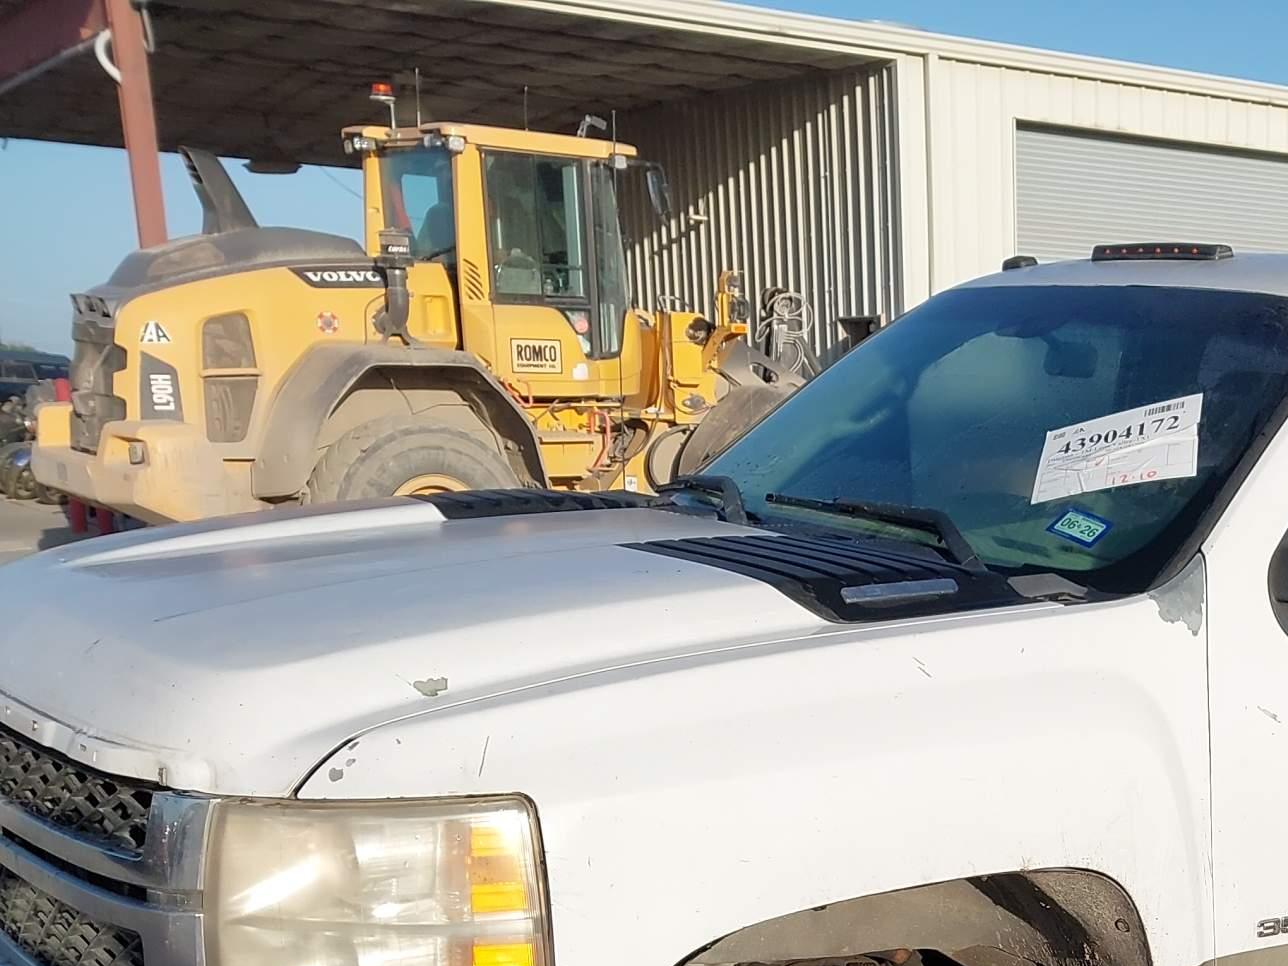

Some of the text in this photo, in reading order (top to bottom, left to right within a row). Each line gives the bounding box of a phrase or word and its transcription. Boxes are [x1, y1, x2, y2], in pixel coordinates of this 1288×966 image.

[516, 344, 557, 362] ROMCO
[149, 374, 175, 411] L90H
[1057, 415, 1180, 455] 43904172
[1060, 518, 1099, 538] 06 26
